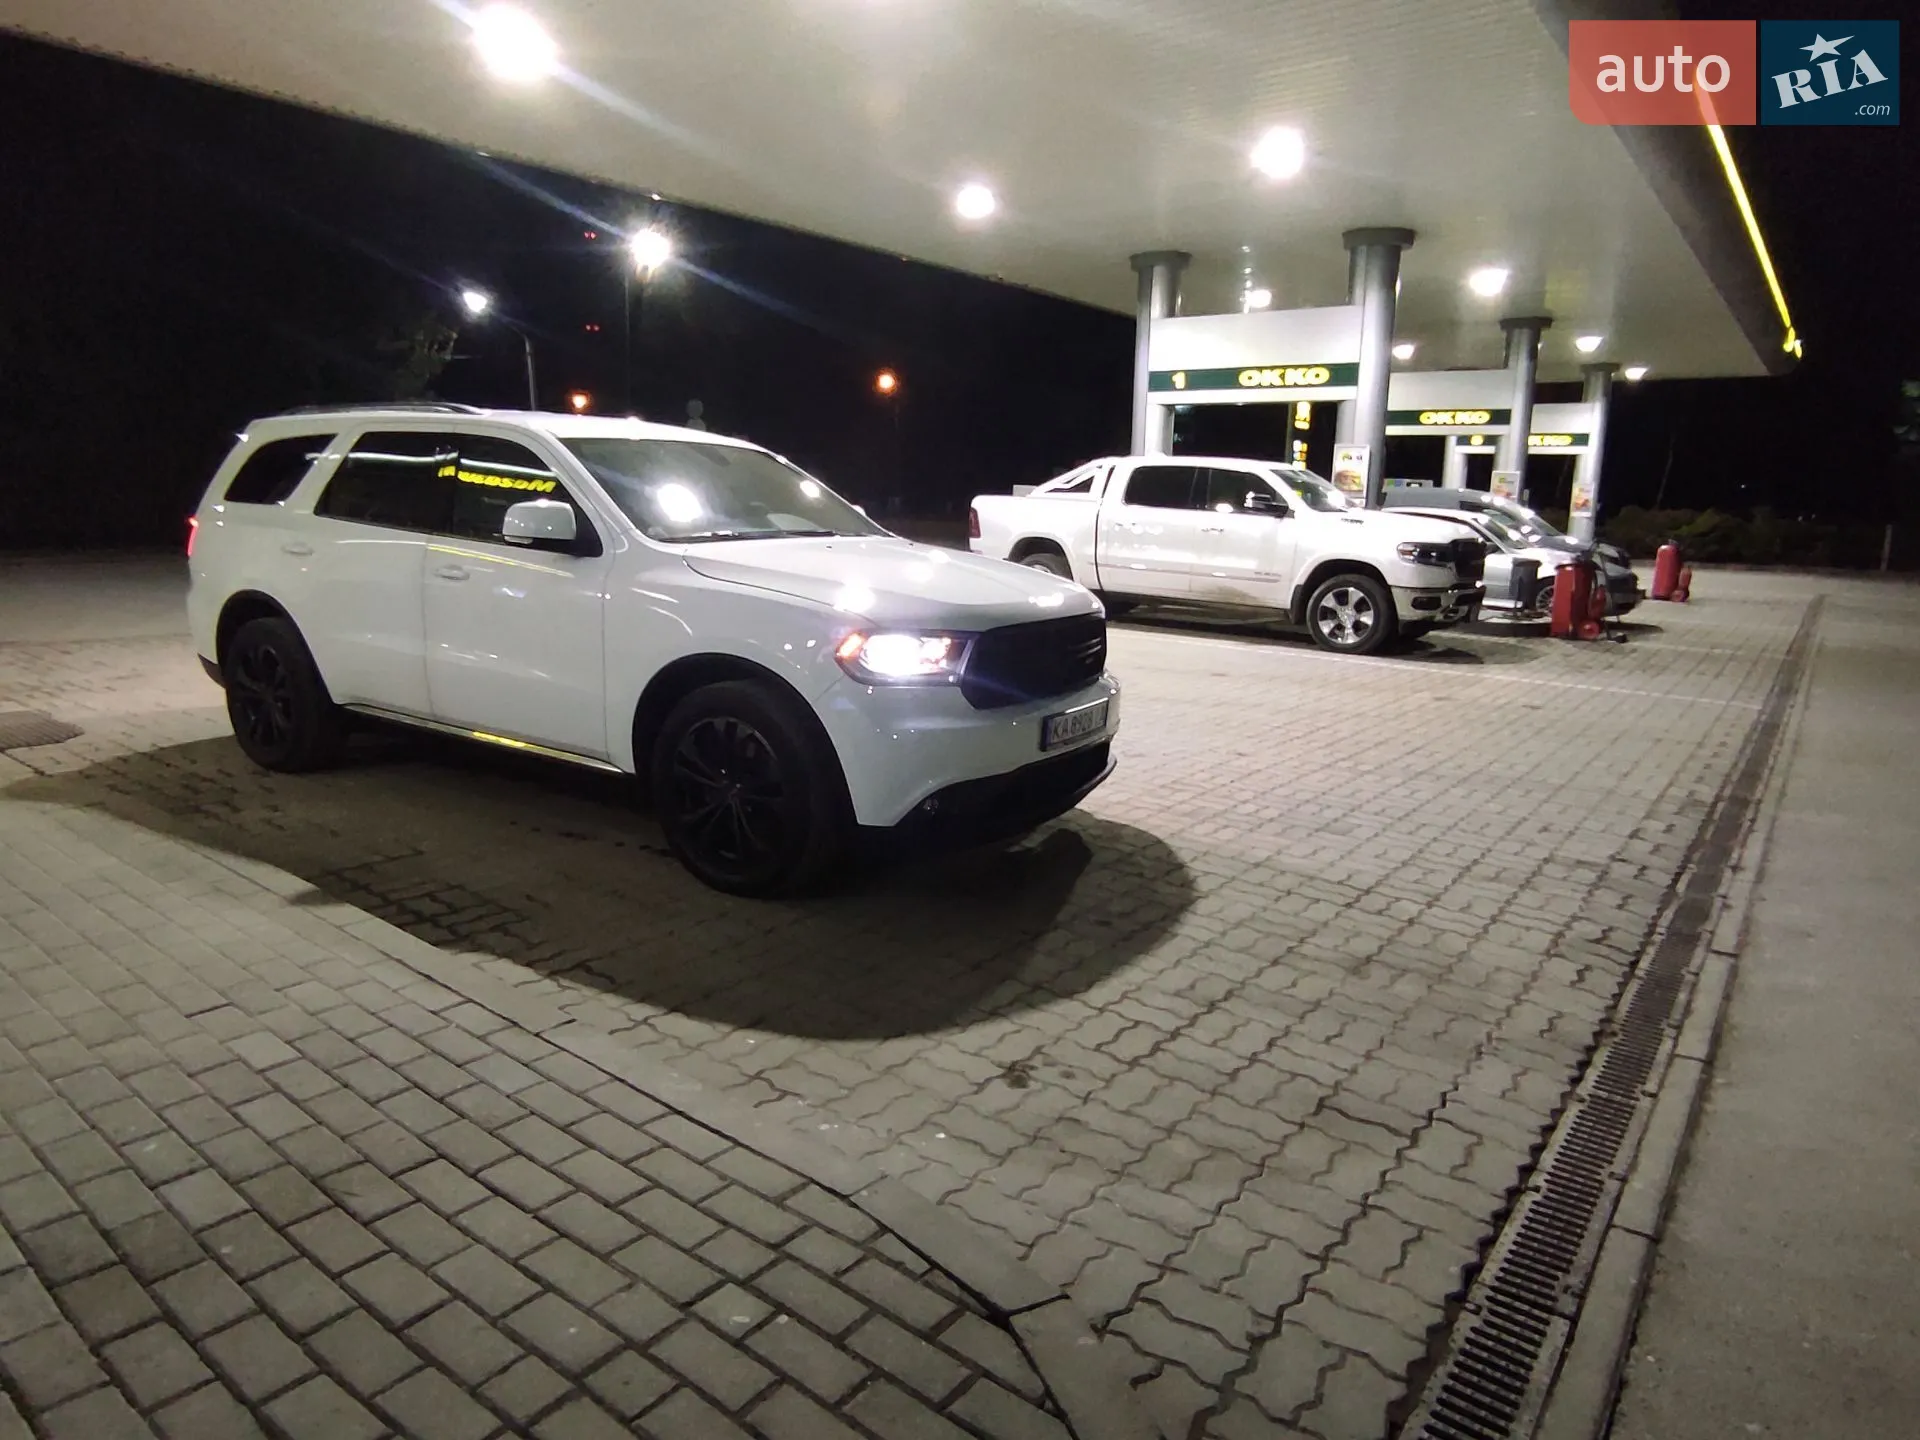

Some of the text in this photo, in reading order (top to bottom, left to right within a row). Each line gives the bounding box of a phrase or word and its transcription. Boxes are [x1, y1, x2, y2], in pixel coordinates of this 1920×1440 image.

[1172, 366, 1331, 390] 1 OKKO
[1419, 410, 1491, 425] OKKO
[1528, 434, 1573, 447] KKO
